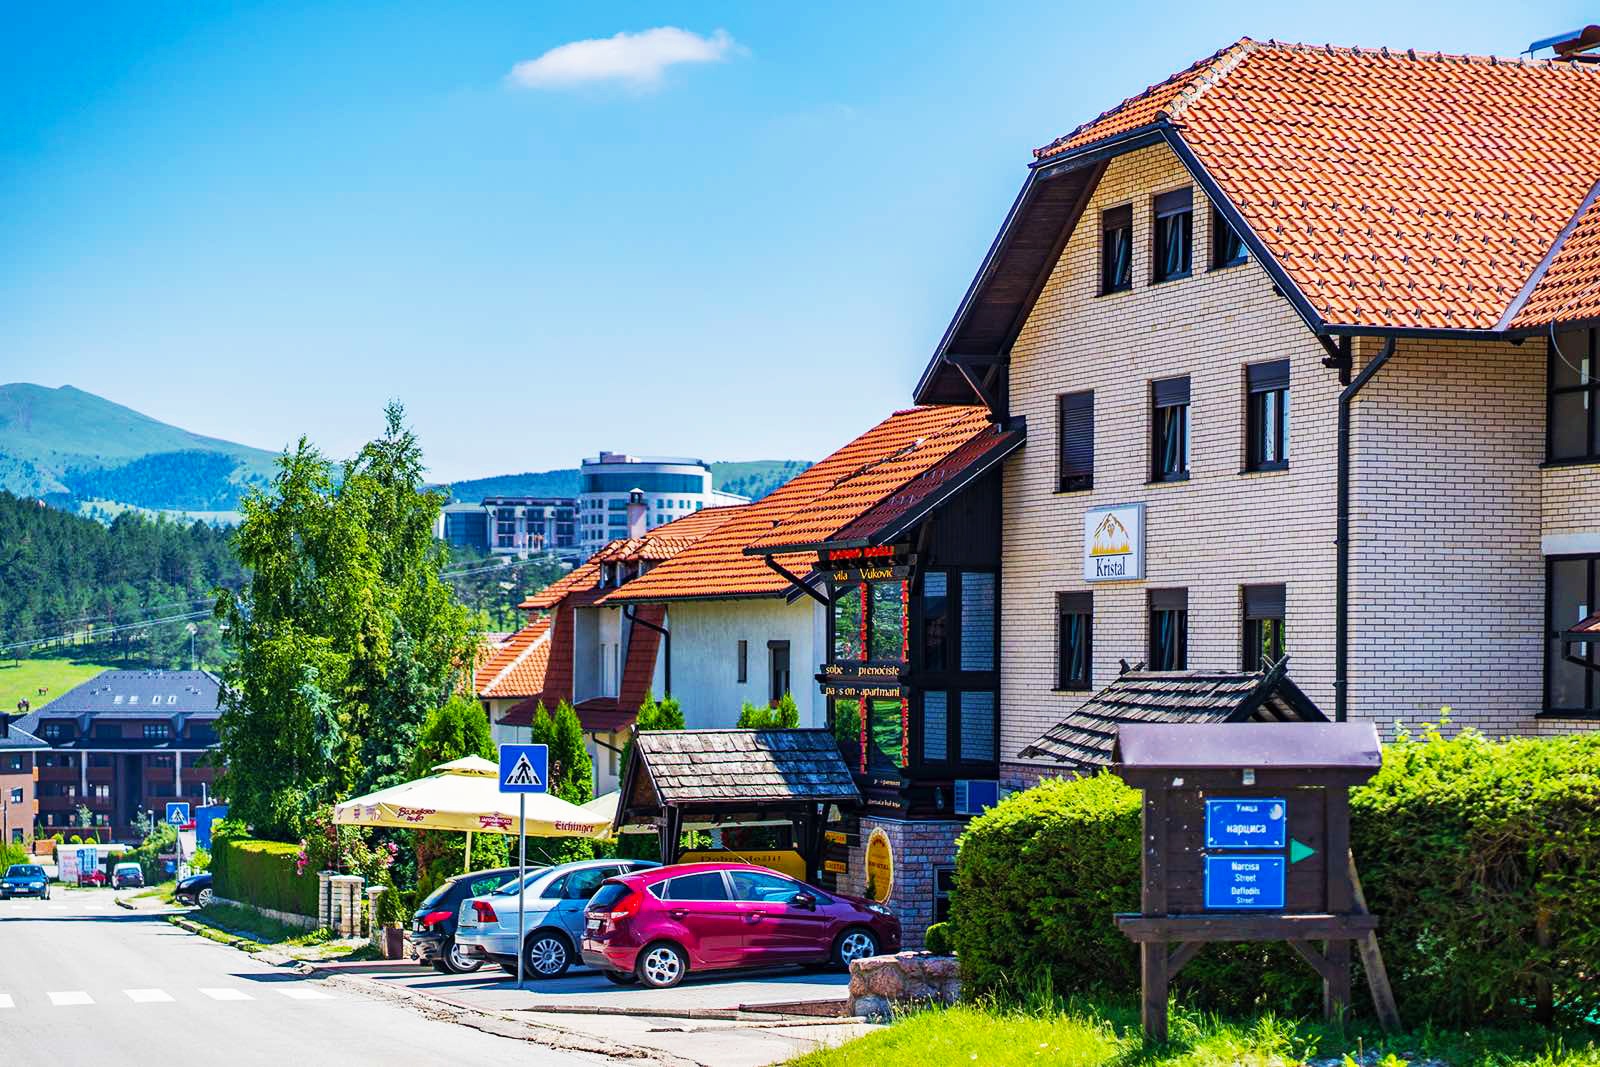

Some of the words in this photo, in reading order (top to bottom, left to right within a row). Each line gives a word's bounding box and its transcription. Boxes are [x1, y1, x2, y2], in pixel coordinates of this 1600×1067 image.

[1096, 556, 1126, 577] Kristal
[833, 569, 848, 581] vila
[825, 664, 844, 675] sobe
[555, 820, 594, 833] Eichinger
[1226, 824, 1267, 836] нарциса
[1231, 861, 1260, 871] Narcisa
[1234, 873, 1257, 882] Street
